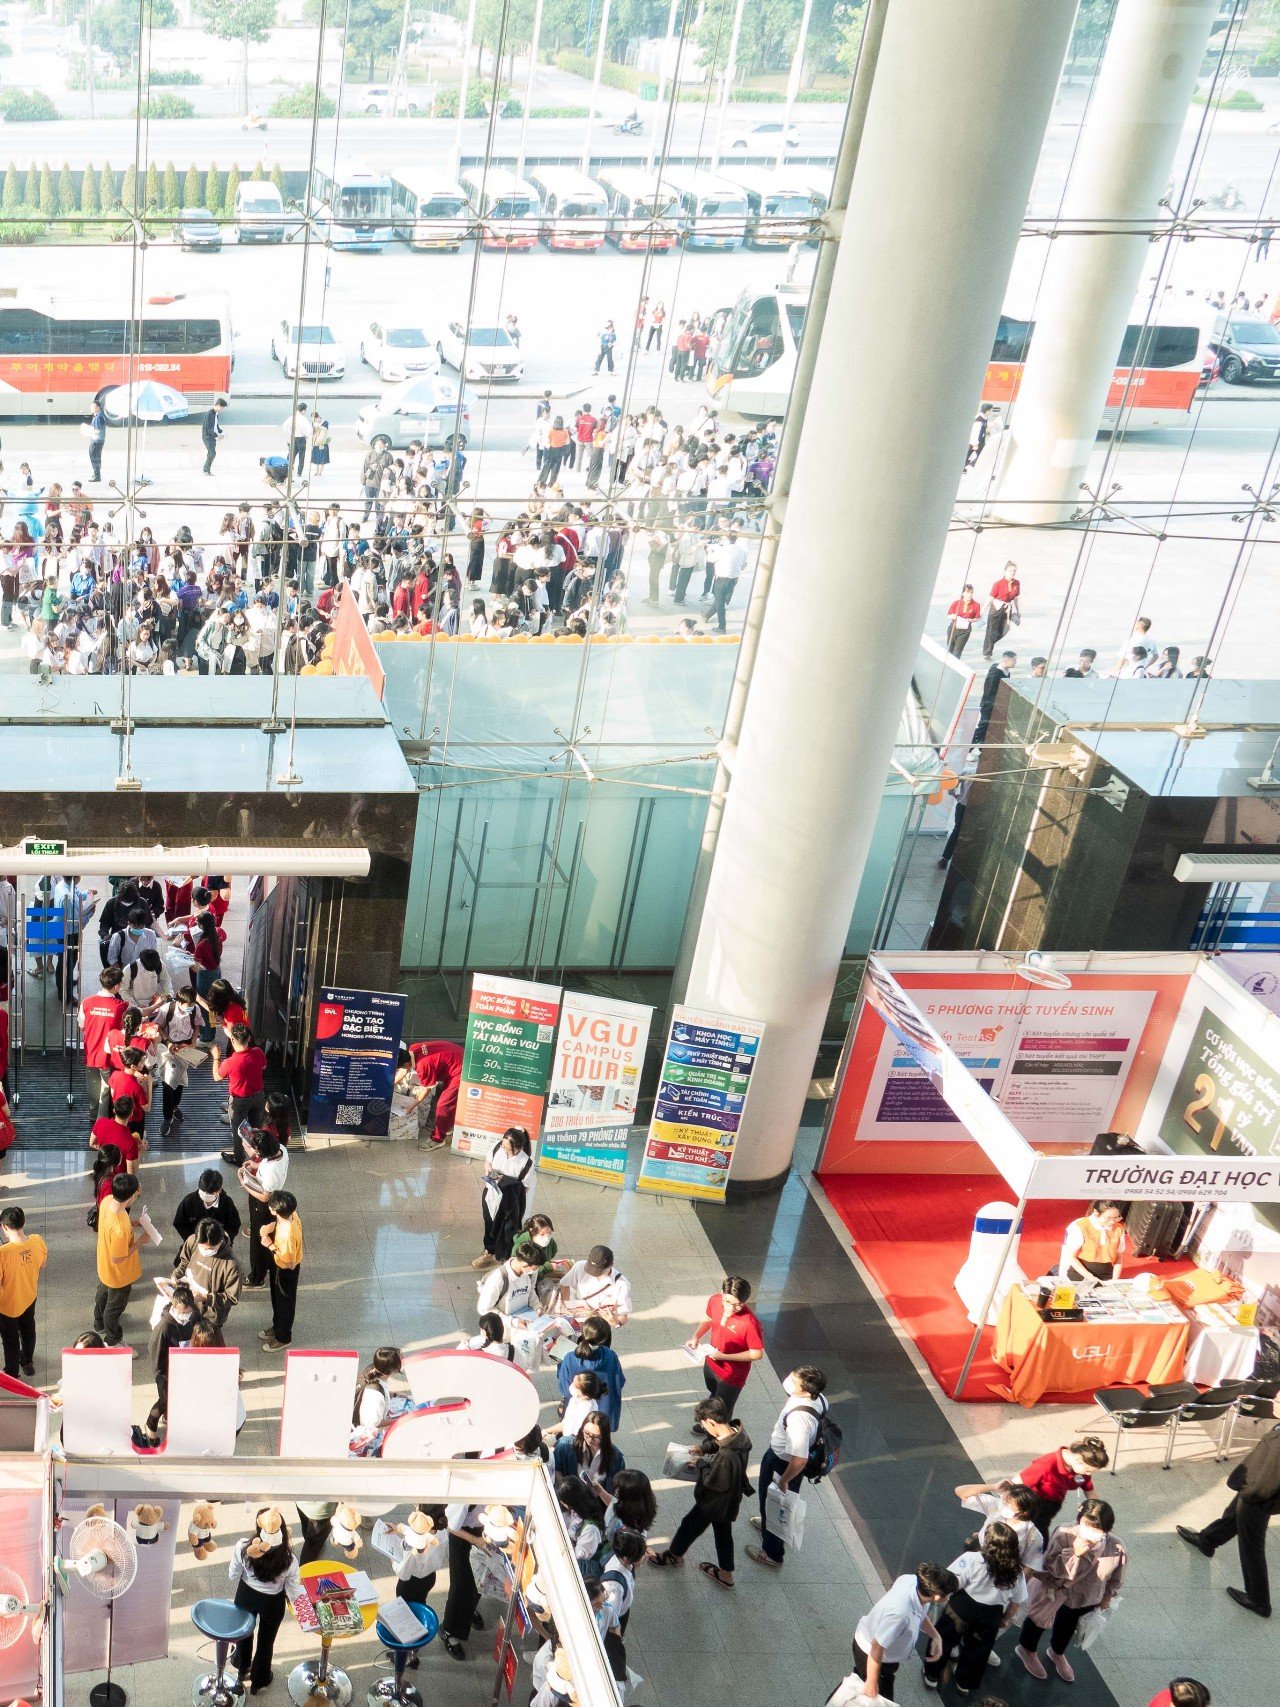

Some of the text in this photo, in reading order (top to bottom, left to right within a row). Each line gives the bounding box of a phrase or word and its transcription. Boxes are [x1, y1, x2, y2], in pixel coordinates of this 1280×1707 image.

[480, 994, 517, 1007] HỌC BỔNG
[475, 1002, 516, 1016] TOÀN PHẦN
[927, 1000, 1114, 1016] 5 PHƯƠNG THỨC TUYỂN SINH
[343, 1015, 384, 1025] ĐÀO TẠO
[342, 1025, 385, 1034] ĐẶC BIỆT
[473, 1019, 523, 1036] HỌC BỔNG
[567, 1013, 639, 1048] VGU
[472, 1030, 540, 1051] TÀI NĂNG VGU
[694, 1035, 730, 1047] MÁY TÍNH
[696, 1030, 733, 1043] KHOA HỌC
[562, 1039, 633, 1063] CAMPUS
[1205, 1029, 1220, 1045] CƠ
[1219, 1039, 1237, 1062] HỘI
[1235, 1055, 1257, 1081] HỌC
[561, 1052, 619, 1080] TOUR
[686, 1076, 725, 1087] KINH DOANH
[1200, 1045, 1276, 1126] Tổng giá trị
[689, 1089, 709, 1098] CHÍNH
[678, 1107, 723, 1122] KIẾN TRÚC
[546, 1128, 628, 1144] Hệ thống 79 PHÒNG LAB
[677, 1133, 712, 1144] XÂY DỰNG
[679, 1126, 713, 1138] KỸ THUẬT
[557, 1151, 569, 1161] Best
[569, 1153, 587, 1163] Green
[677, 1144, 710, 1157] KỸ THUẬT
[684, 1152, 708, 1163] CƠ KHÍ
[1085, 1164, 1272, 1190] TRƯỜNG ĐẠI HỌC
